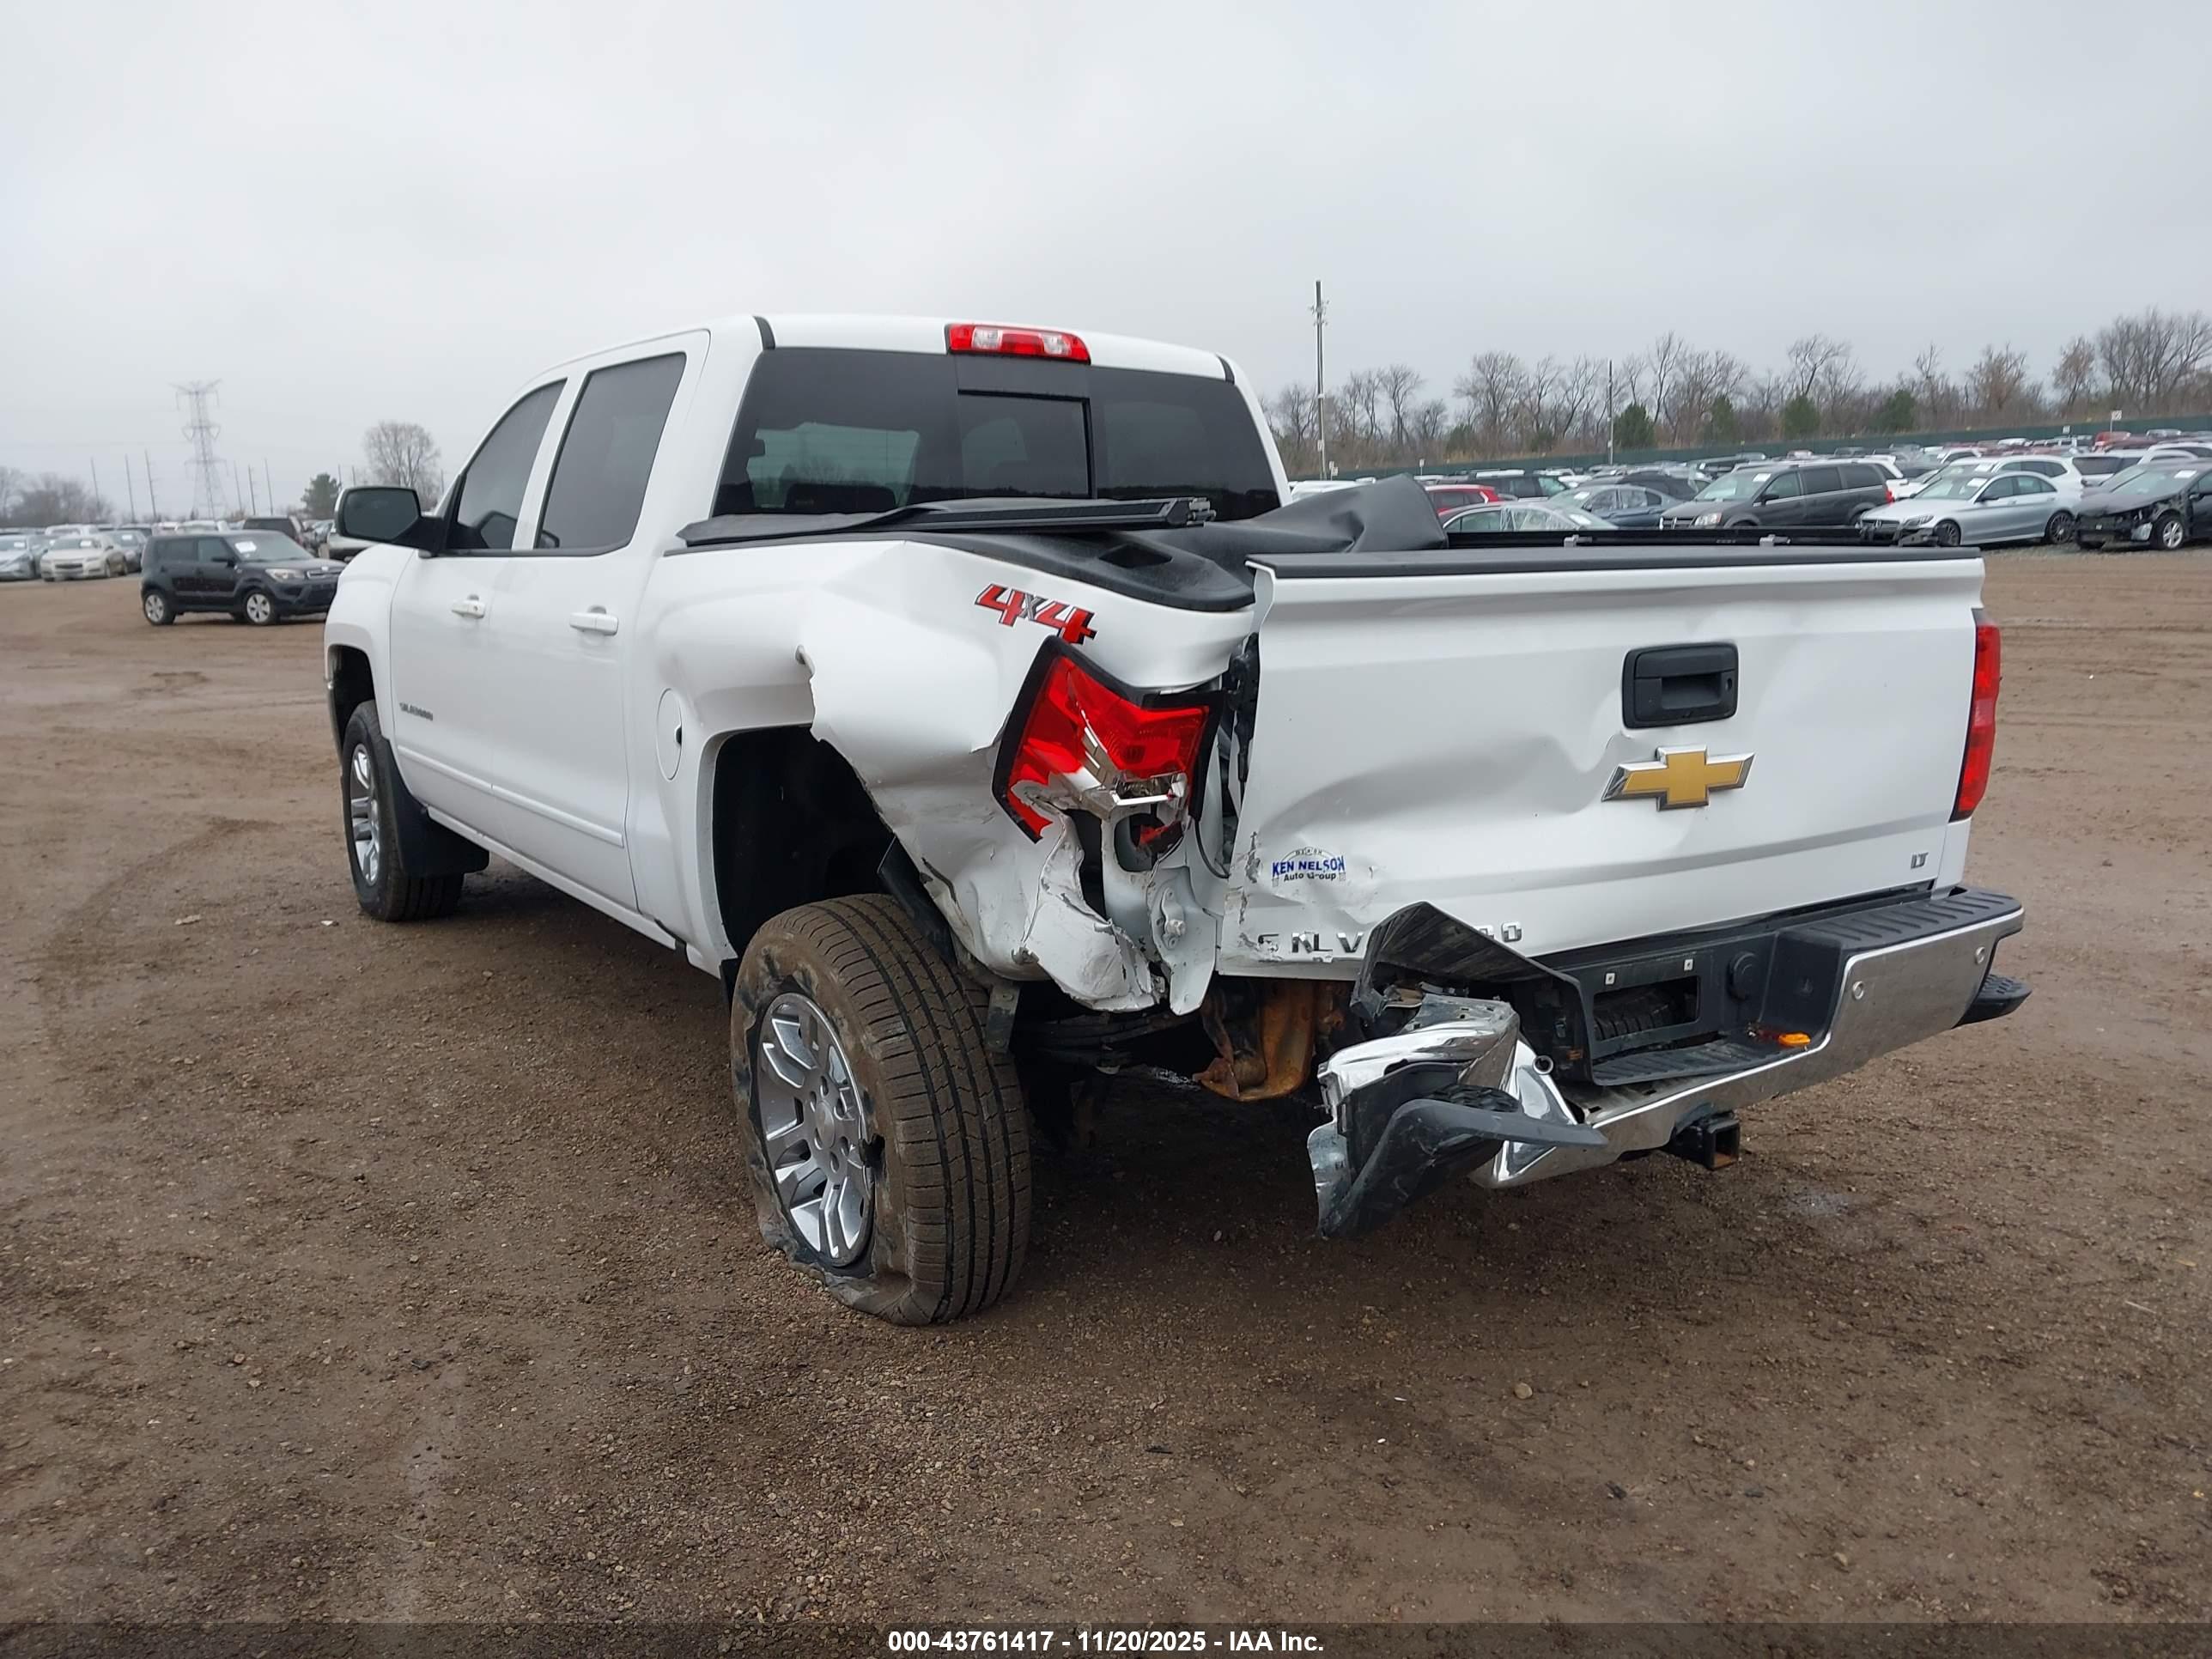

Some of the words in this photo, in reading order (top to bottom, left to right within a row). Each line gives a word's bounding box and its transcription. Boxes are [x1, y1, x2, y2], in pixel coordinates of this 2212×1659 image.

[1273, 861, 1294, 877] KEN
[1298, 856, 1346, 872] NELSON
[1911, 852, 1929, 869] LT
[1284, 872, 1304, 883] Auto
